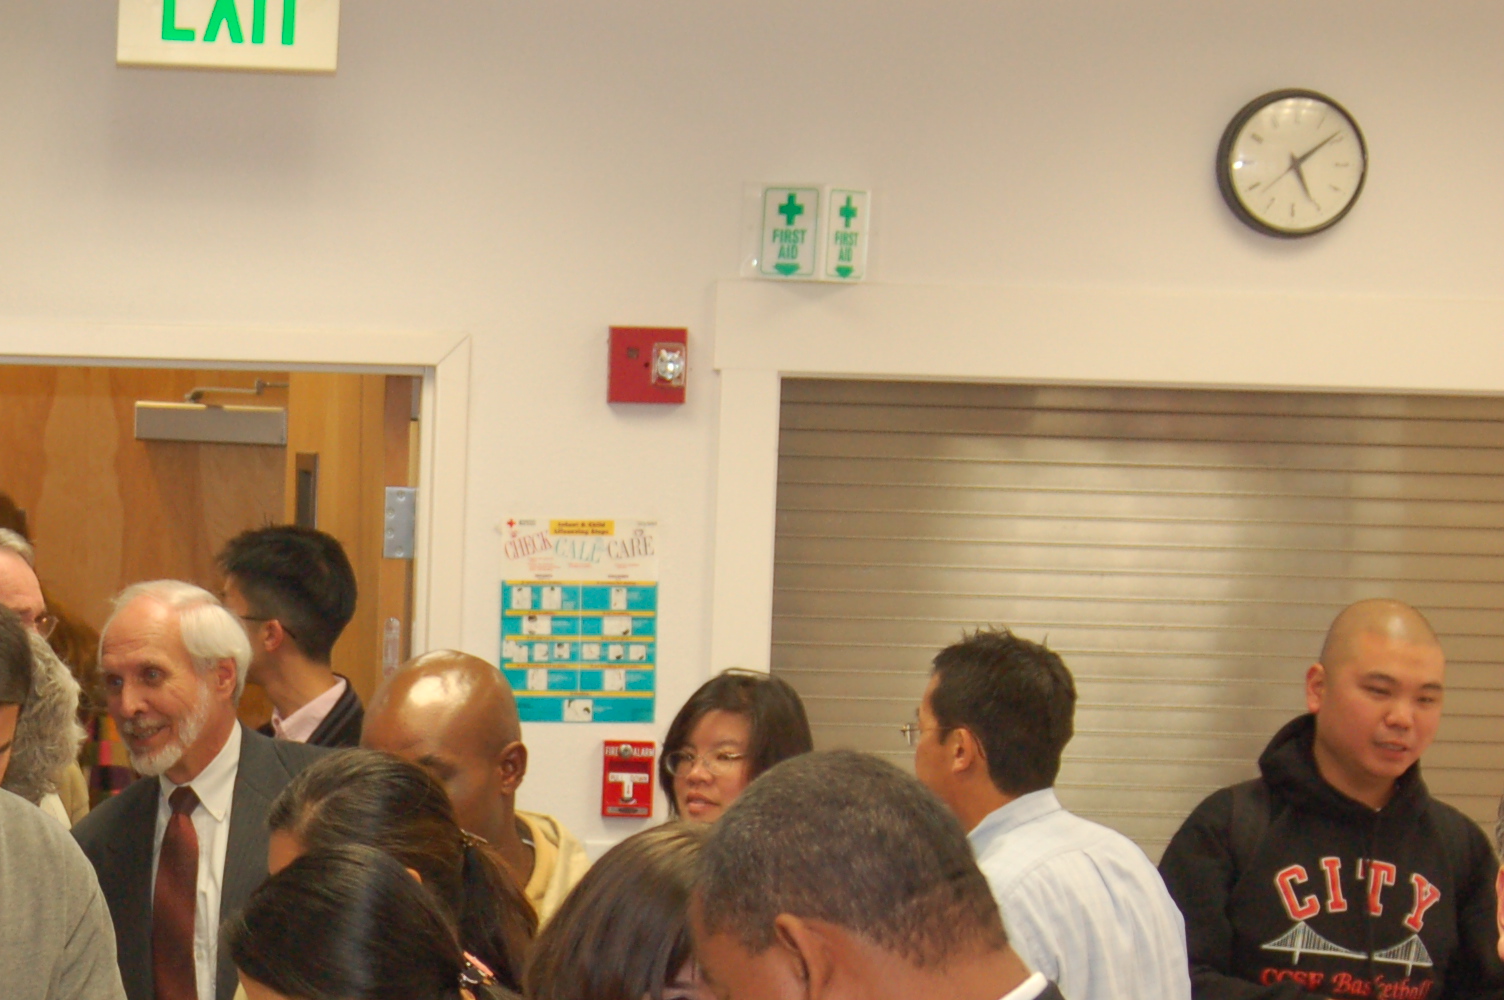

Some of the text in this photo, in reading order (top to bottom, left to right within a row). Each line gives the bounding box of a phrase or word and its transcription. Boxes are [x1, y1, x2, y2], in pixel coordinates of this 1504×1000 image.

[772, 229, 807, 244] FIRST
[834, 231, 859, 246] FIRST
[778, 245, 799, 260] AID
[838, 247, 853, 262] AID
[504, 531, 655, 563] CHECK CALL CARE
[1274, 856, 1441, 933] CITY
